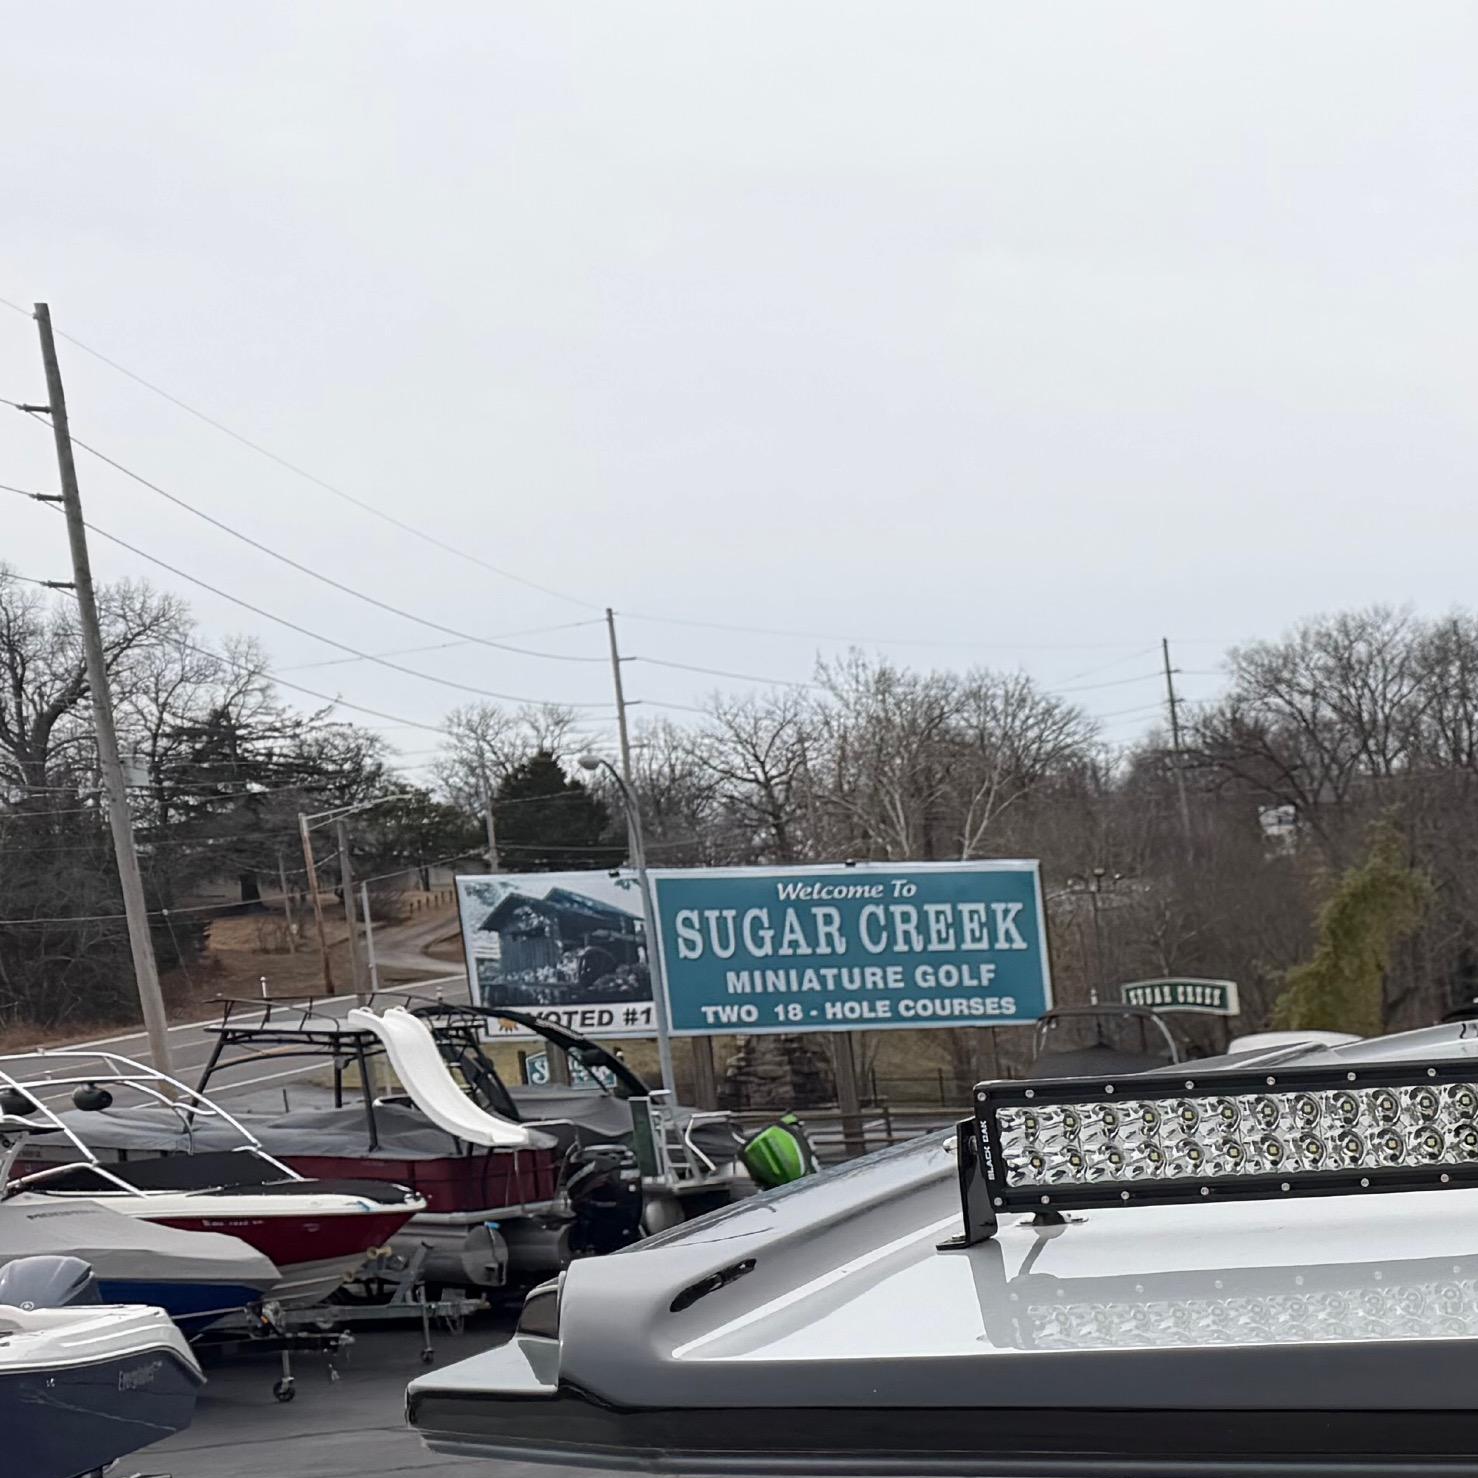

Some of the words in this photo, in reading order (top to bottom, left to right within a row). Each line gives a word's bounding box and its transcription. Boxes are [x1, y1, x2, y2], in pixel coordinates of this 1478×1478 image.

[776, 881, 884, 901] Welcome
[891, 879, 918, 898] To
[675, 906, 847, 959] SUGAR
[858, 902, 1028, 954] CREEK
[726, 966, 905, 994] MINIATURE
[914, 963, 996, 988] GOLF
[622, 1007, 653, 1026] #1
[701, 1004, 759, 1024] TWO
[774, 1003, 803, 1022] 18
[825, 1000, 892, 1020] HOLE
[898, 996, 1017, 1018] COURSES
[983, 1146, 995, 1180] BLACK
